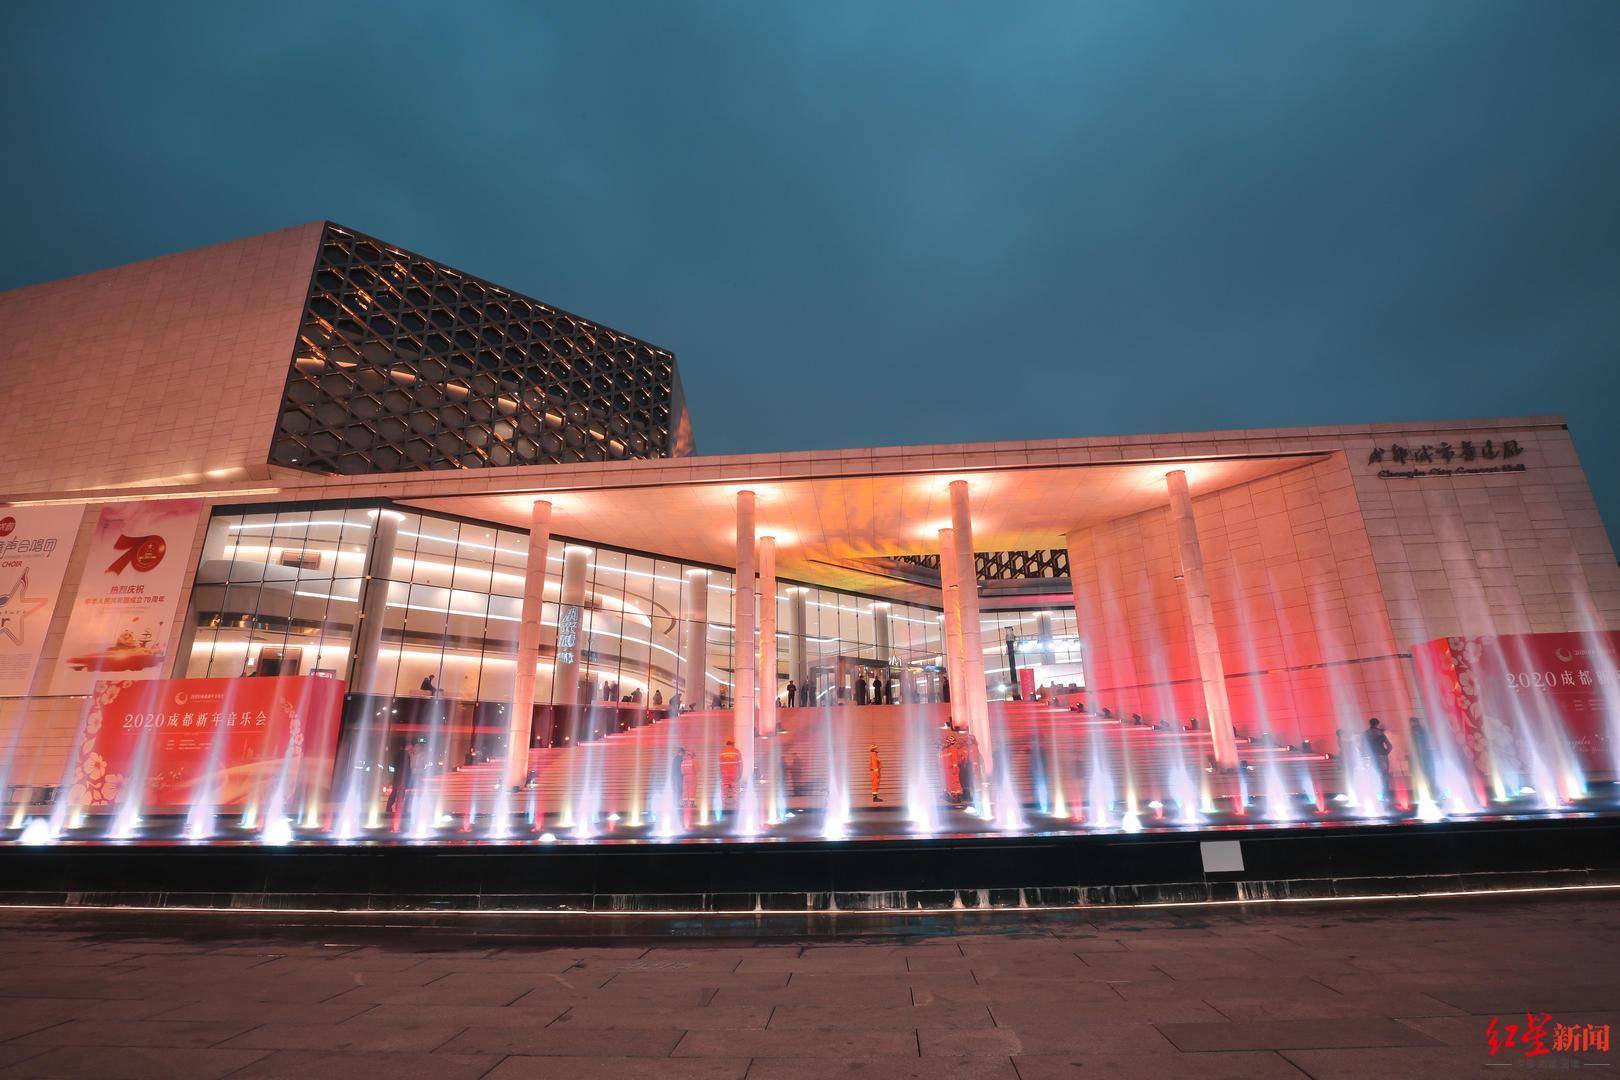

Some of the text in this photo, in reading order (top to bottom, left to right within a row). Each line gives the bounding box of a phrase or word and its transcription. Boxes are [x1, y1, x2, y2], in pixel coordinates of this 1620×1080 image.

[110, 584, 145, 595] 热烈庆祝
[123, 710, 268, 729] 2020成都新年音乐会
